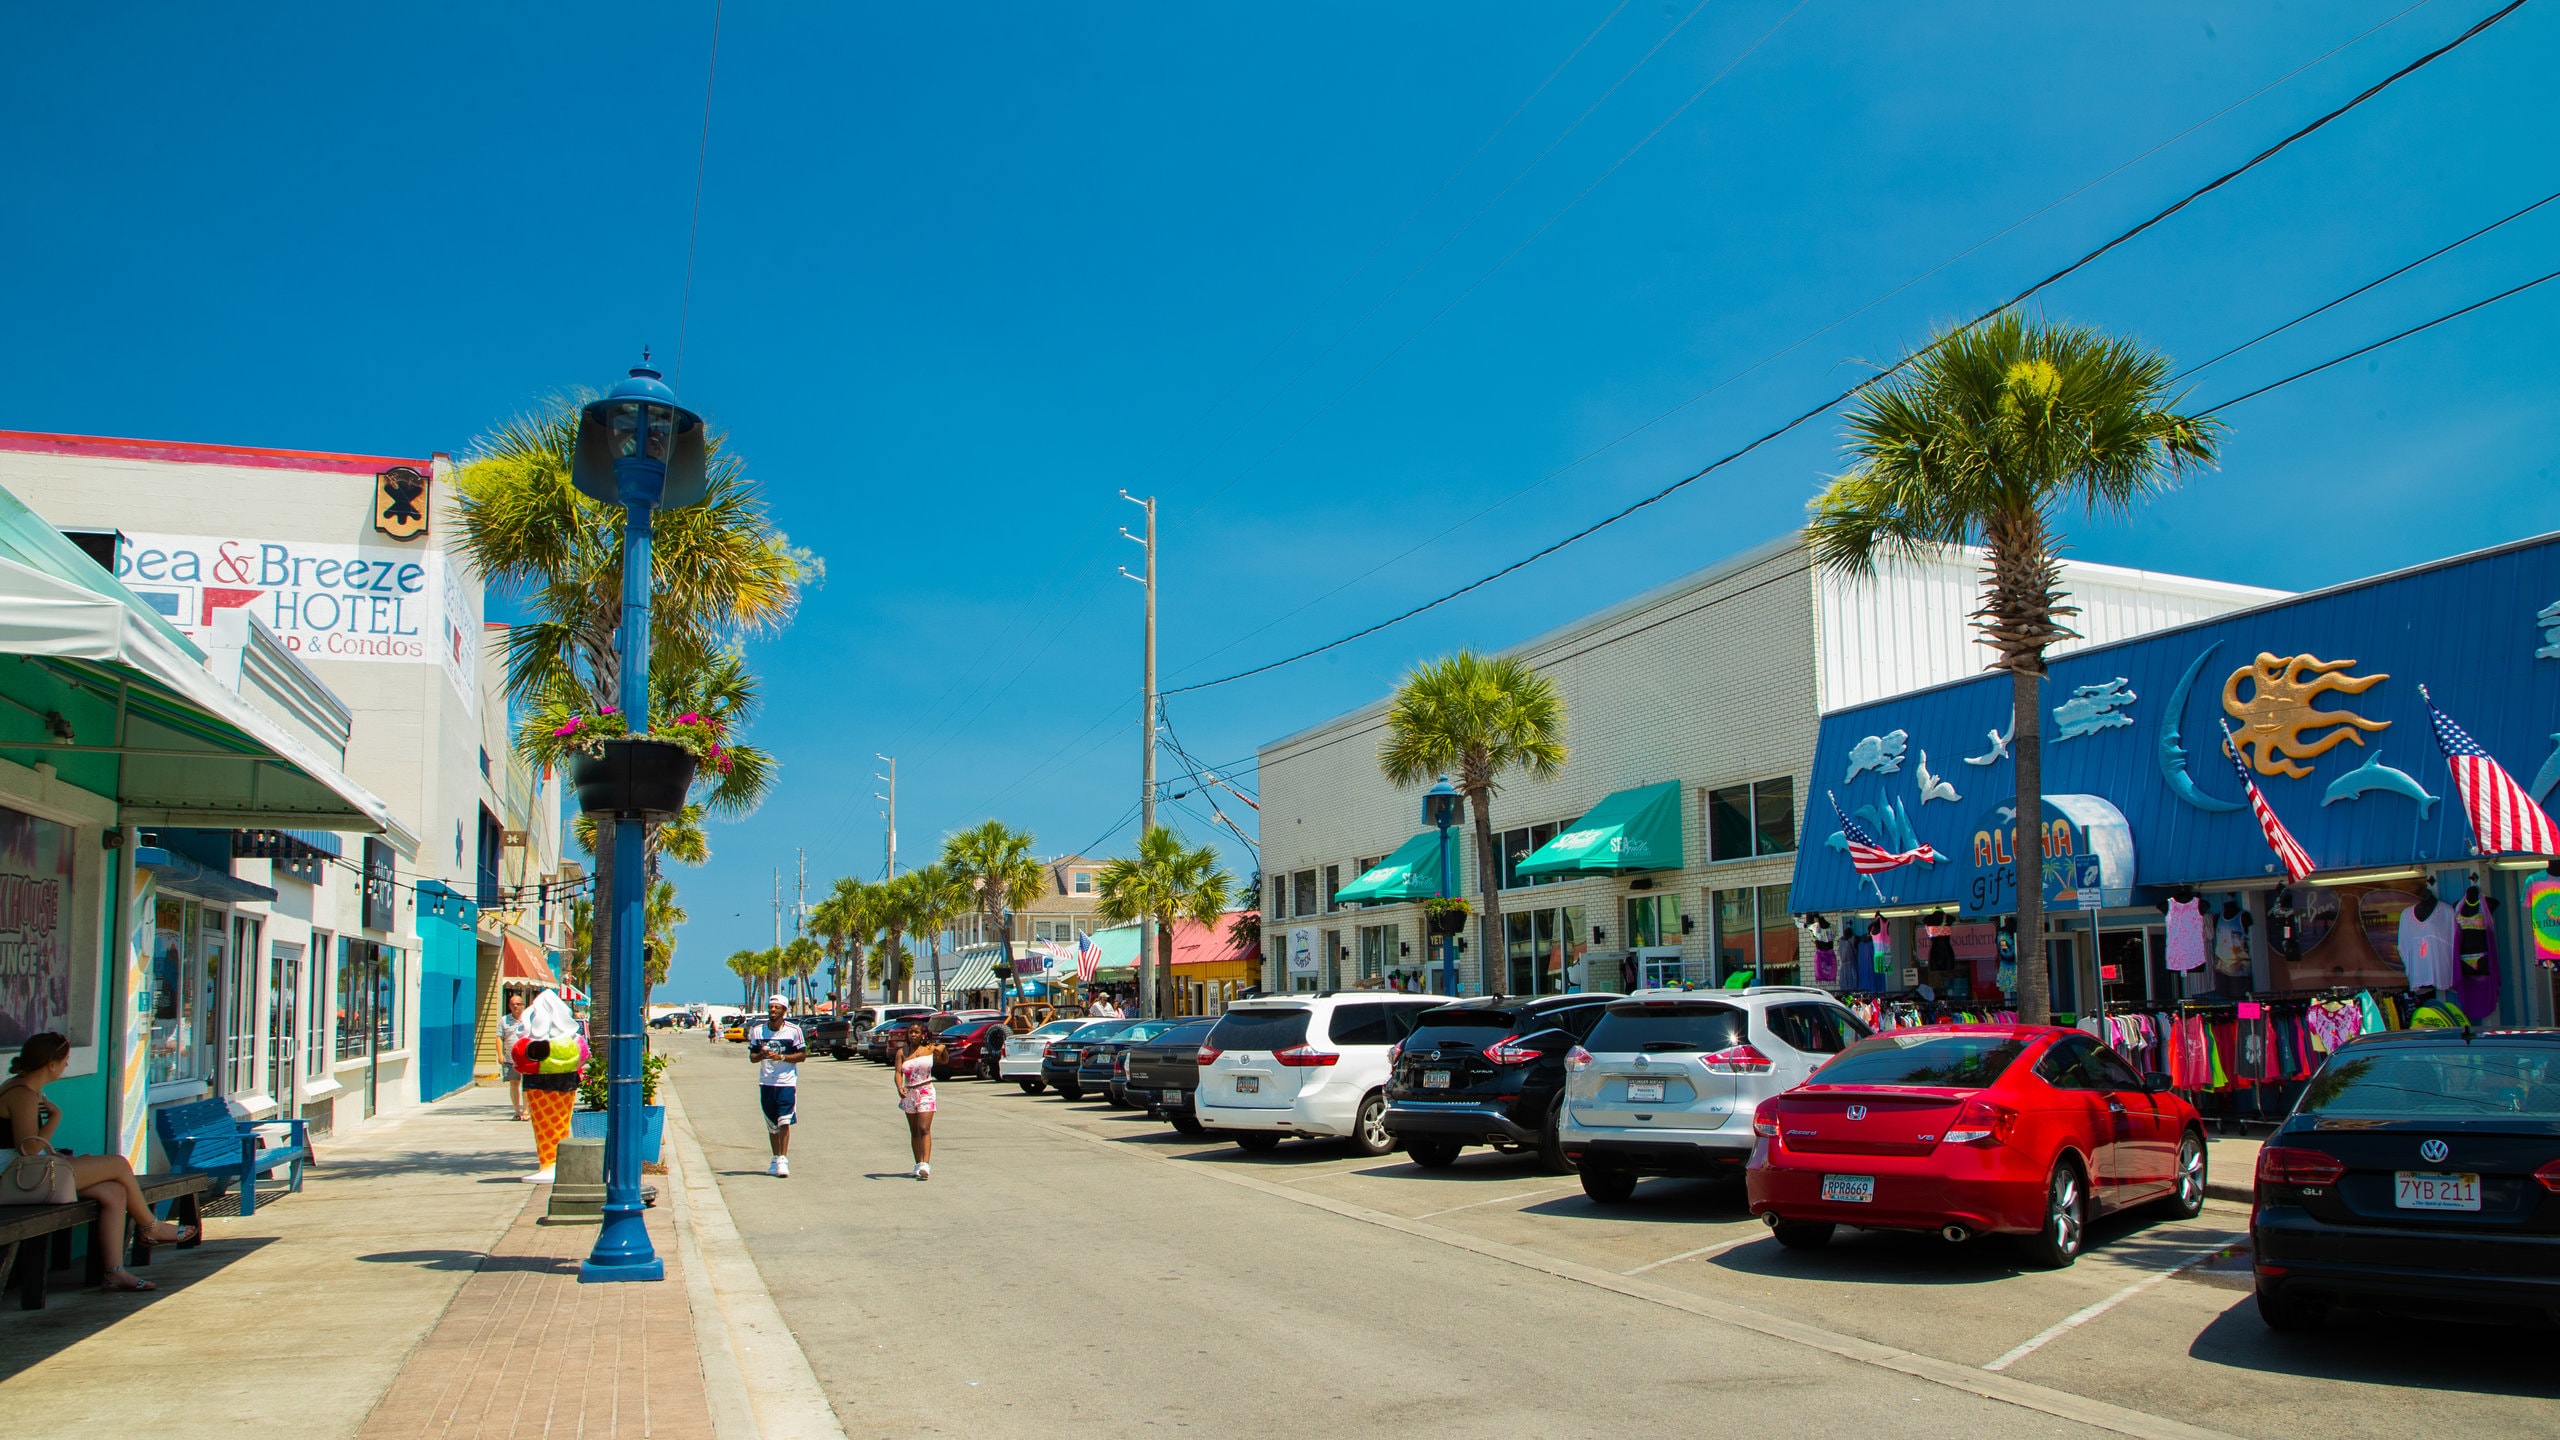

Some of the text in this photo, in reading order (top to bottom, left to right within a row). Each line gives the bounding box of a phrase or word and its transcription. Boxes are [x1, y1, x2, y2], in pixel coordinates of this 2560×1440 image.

[212, 541, 256, 585] &
[257, 543, 426, 593] Breeze
[273, 590, 419, 636] HOTEL
[308, 636, 322, 653] &
[328, 632, 424, 658] Condos
[1974, 818, 2073, 868] ALA
[1951, 928, 1995, 946] southern
[1827, 1181, 1868, 1195] RPR8669
[2400, 1180, 2475, 1202] 7YB 211
